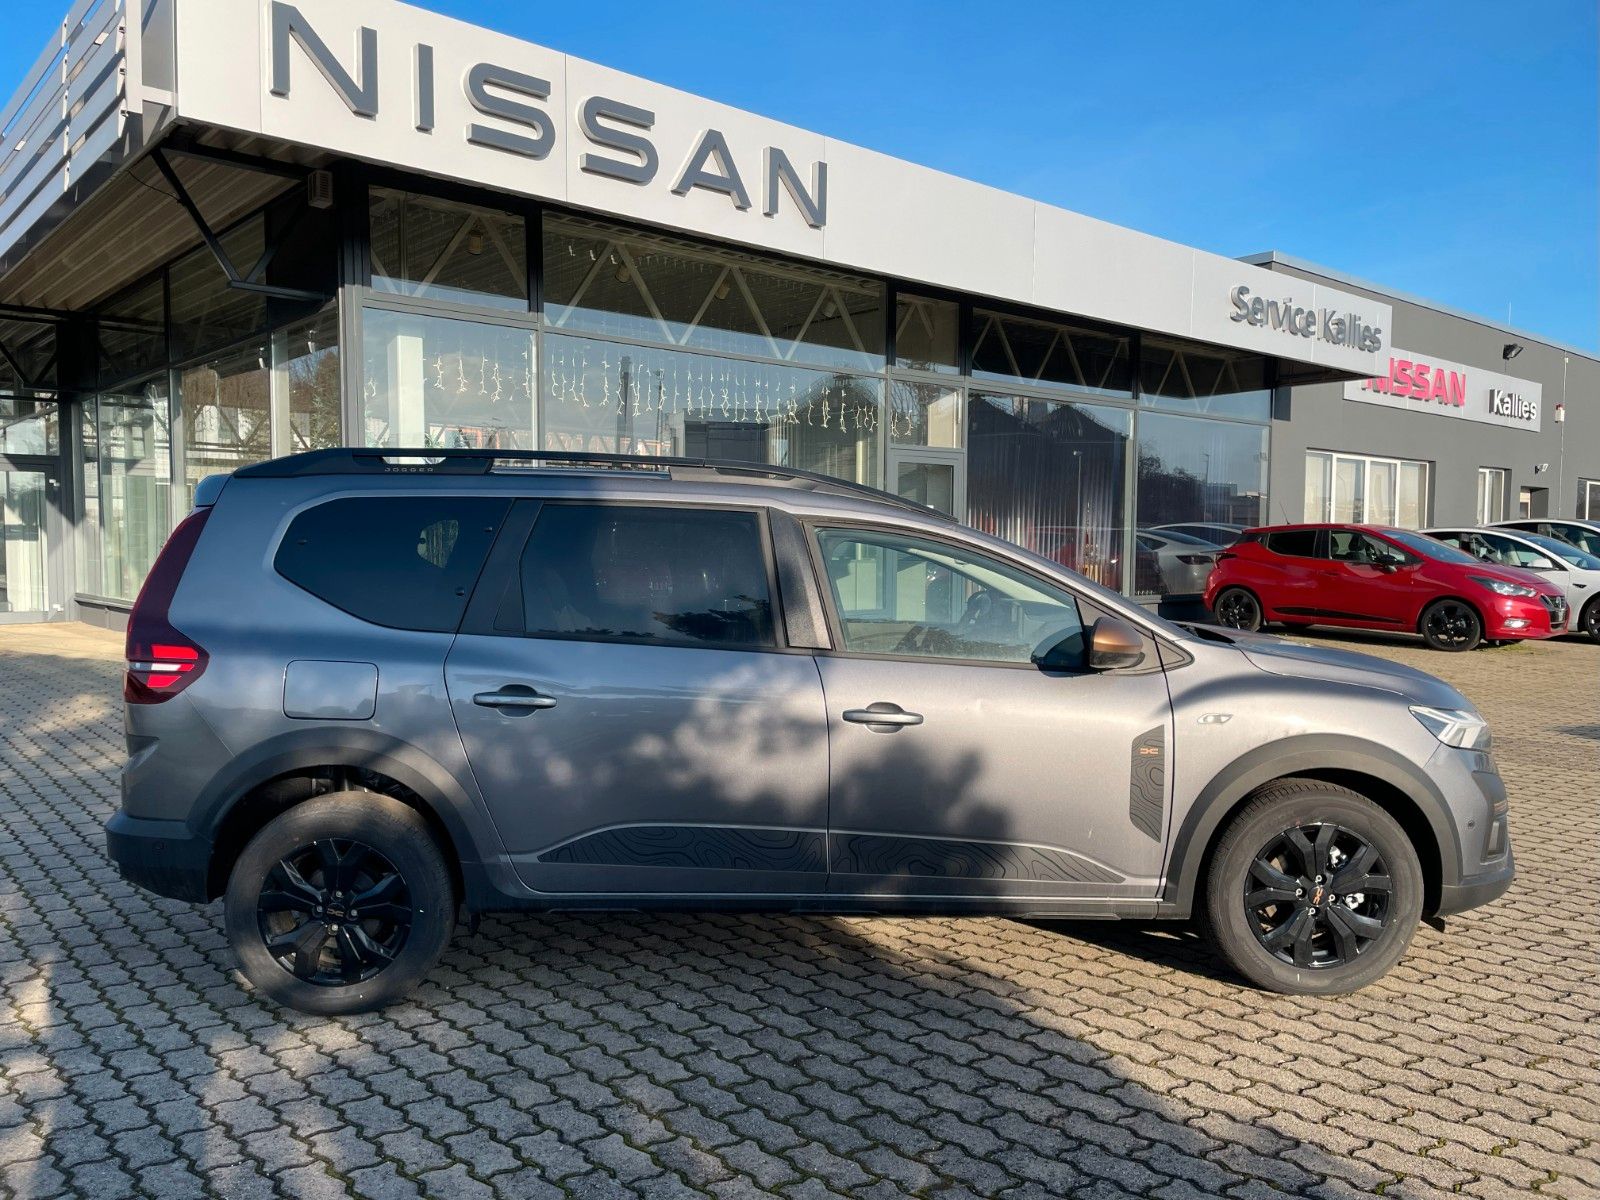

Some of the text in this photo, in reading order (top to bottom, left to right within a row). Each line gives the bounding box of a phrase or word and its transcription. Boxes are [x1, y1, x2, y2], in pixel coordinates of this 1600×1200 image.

[268, 1, 828, 229] NISSAN
[1230, 285, 1382, 353] Service Kallies
[1491, 388, 1537, 420] Kallies
